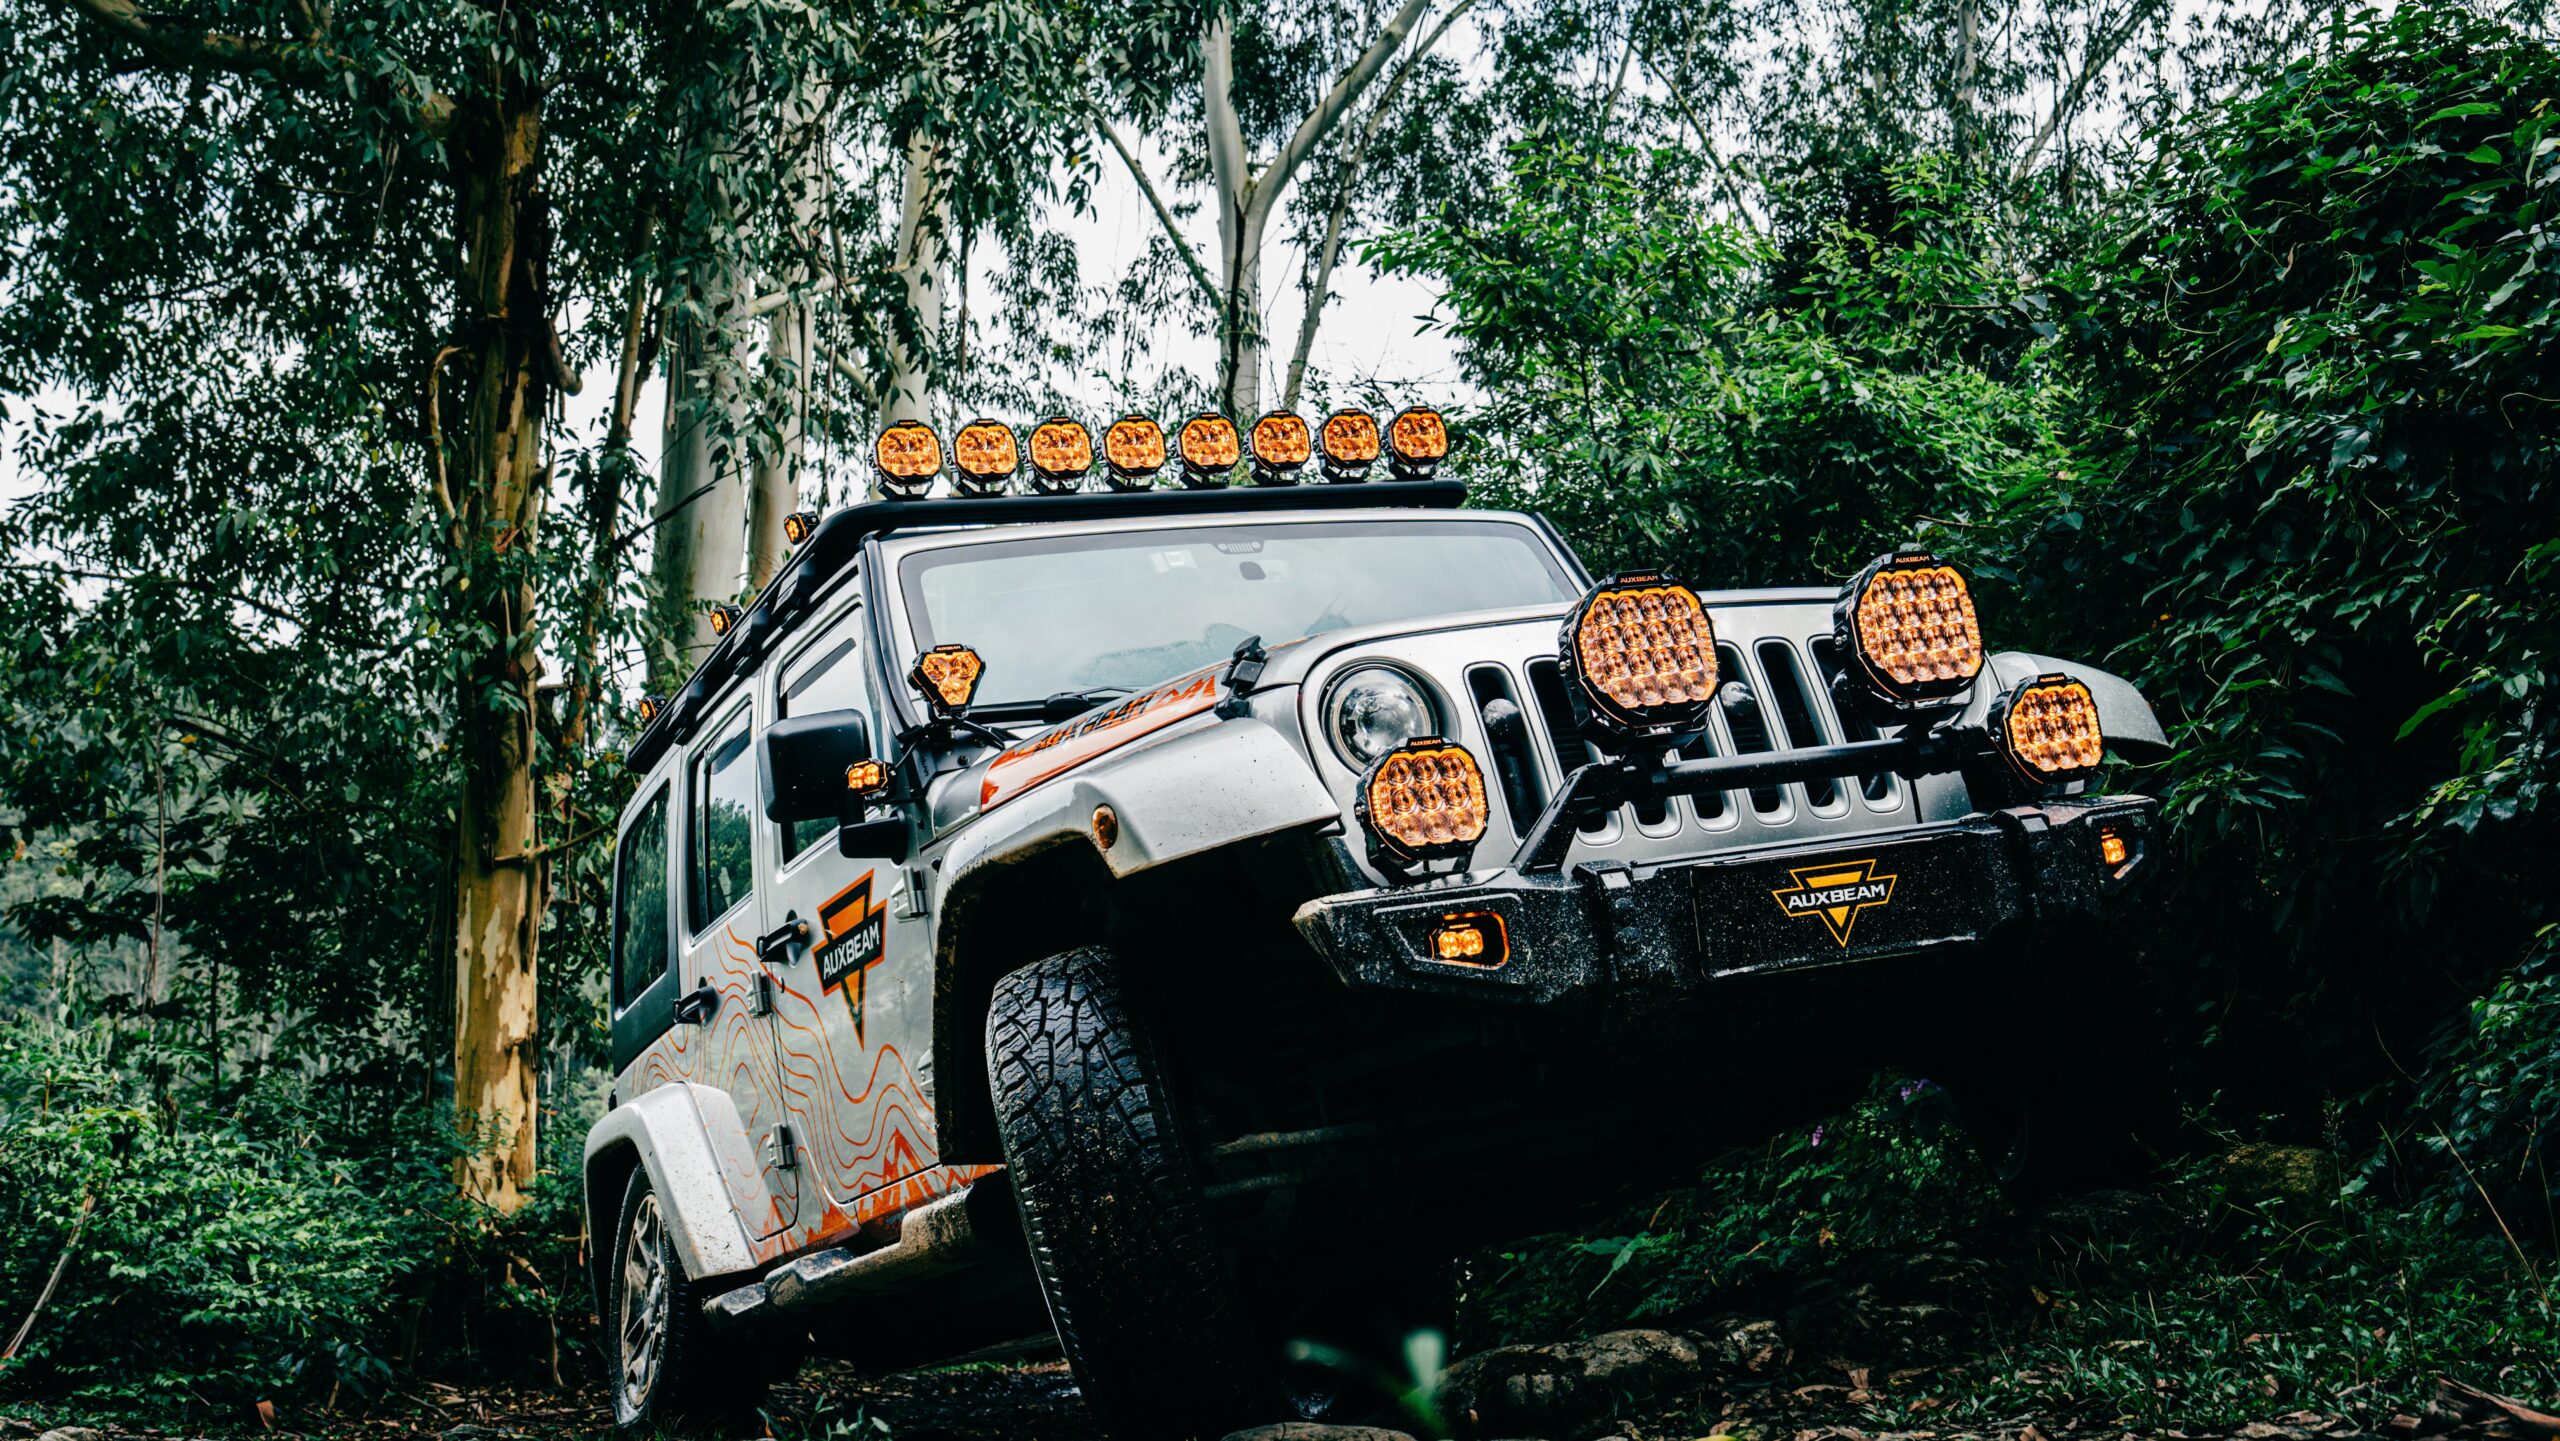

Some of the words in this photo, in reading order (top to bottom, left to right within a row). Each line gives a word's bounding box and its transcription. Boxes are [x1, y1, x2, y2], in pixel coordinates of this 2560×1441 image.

[1895, 554, 1930, 564] AUXBEAM
[1620, 575, 1659, 583] AUXBEAM
[1410, 738, 1442, 747] AUXBEAM
[1788, 883, 1886, 909] AUXBEAM
[823, 920, 880, 981] AUXBEAM
